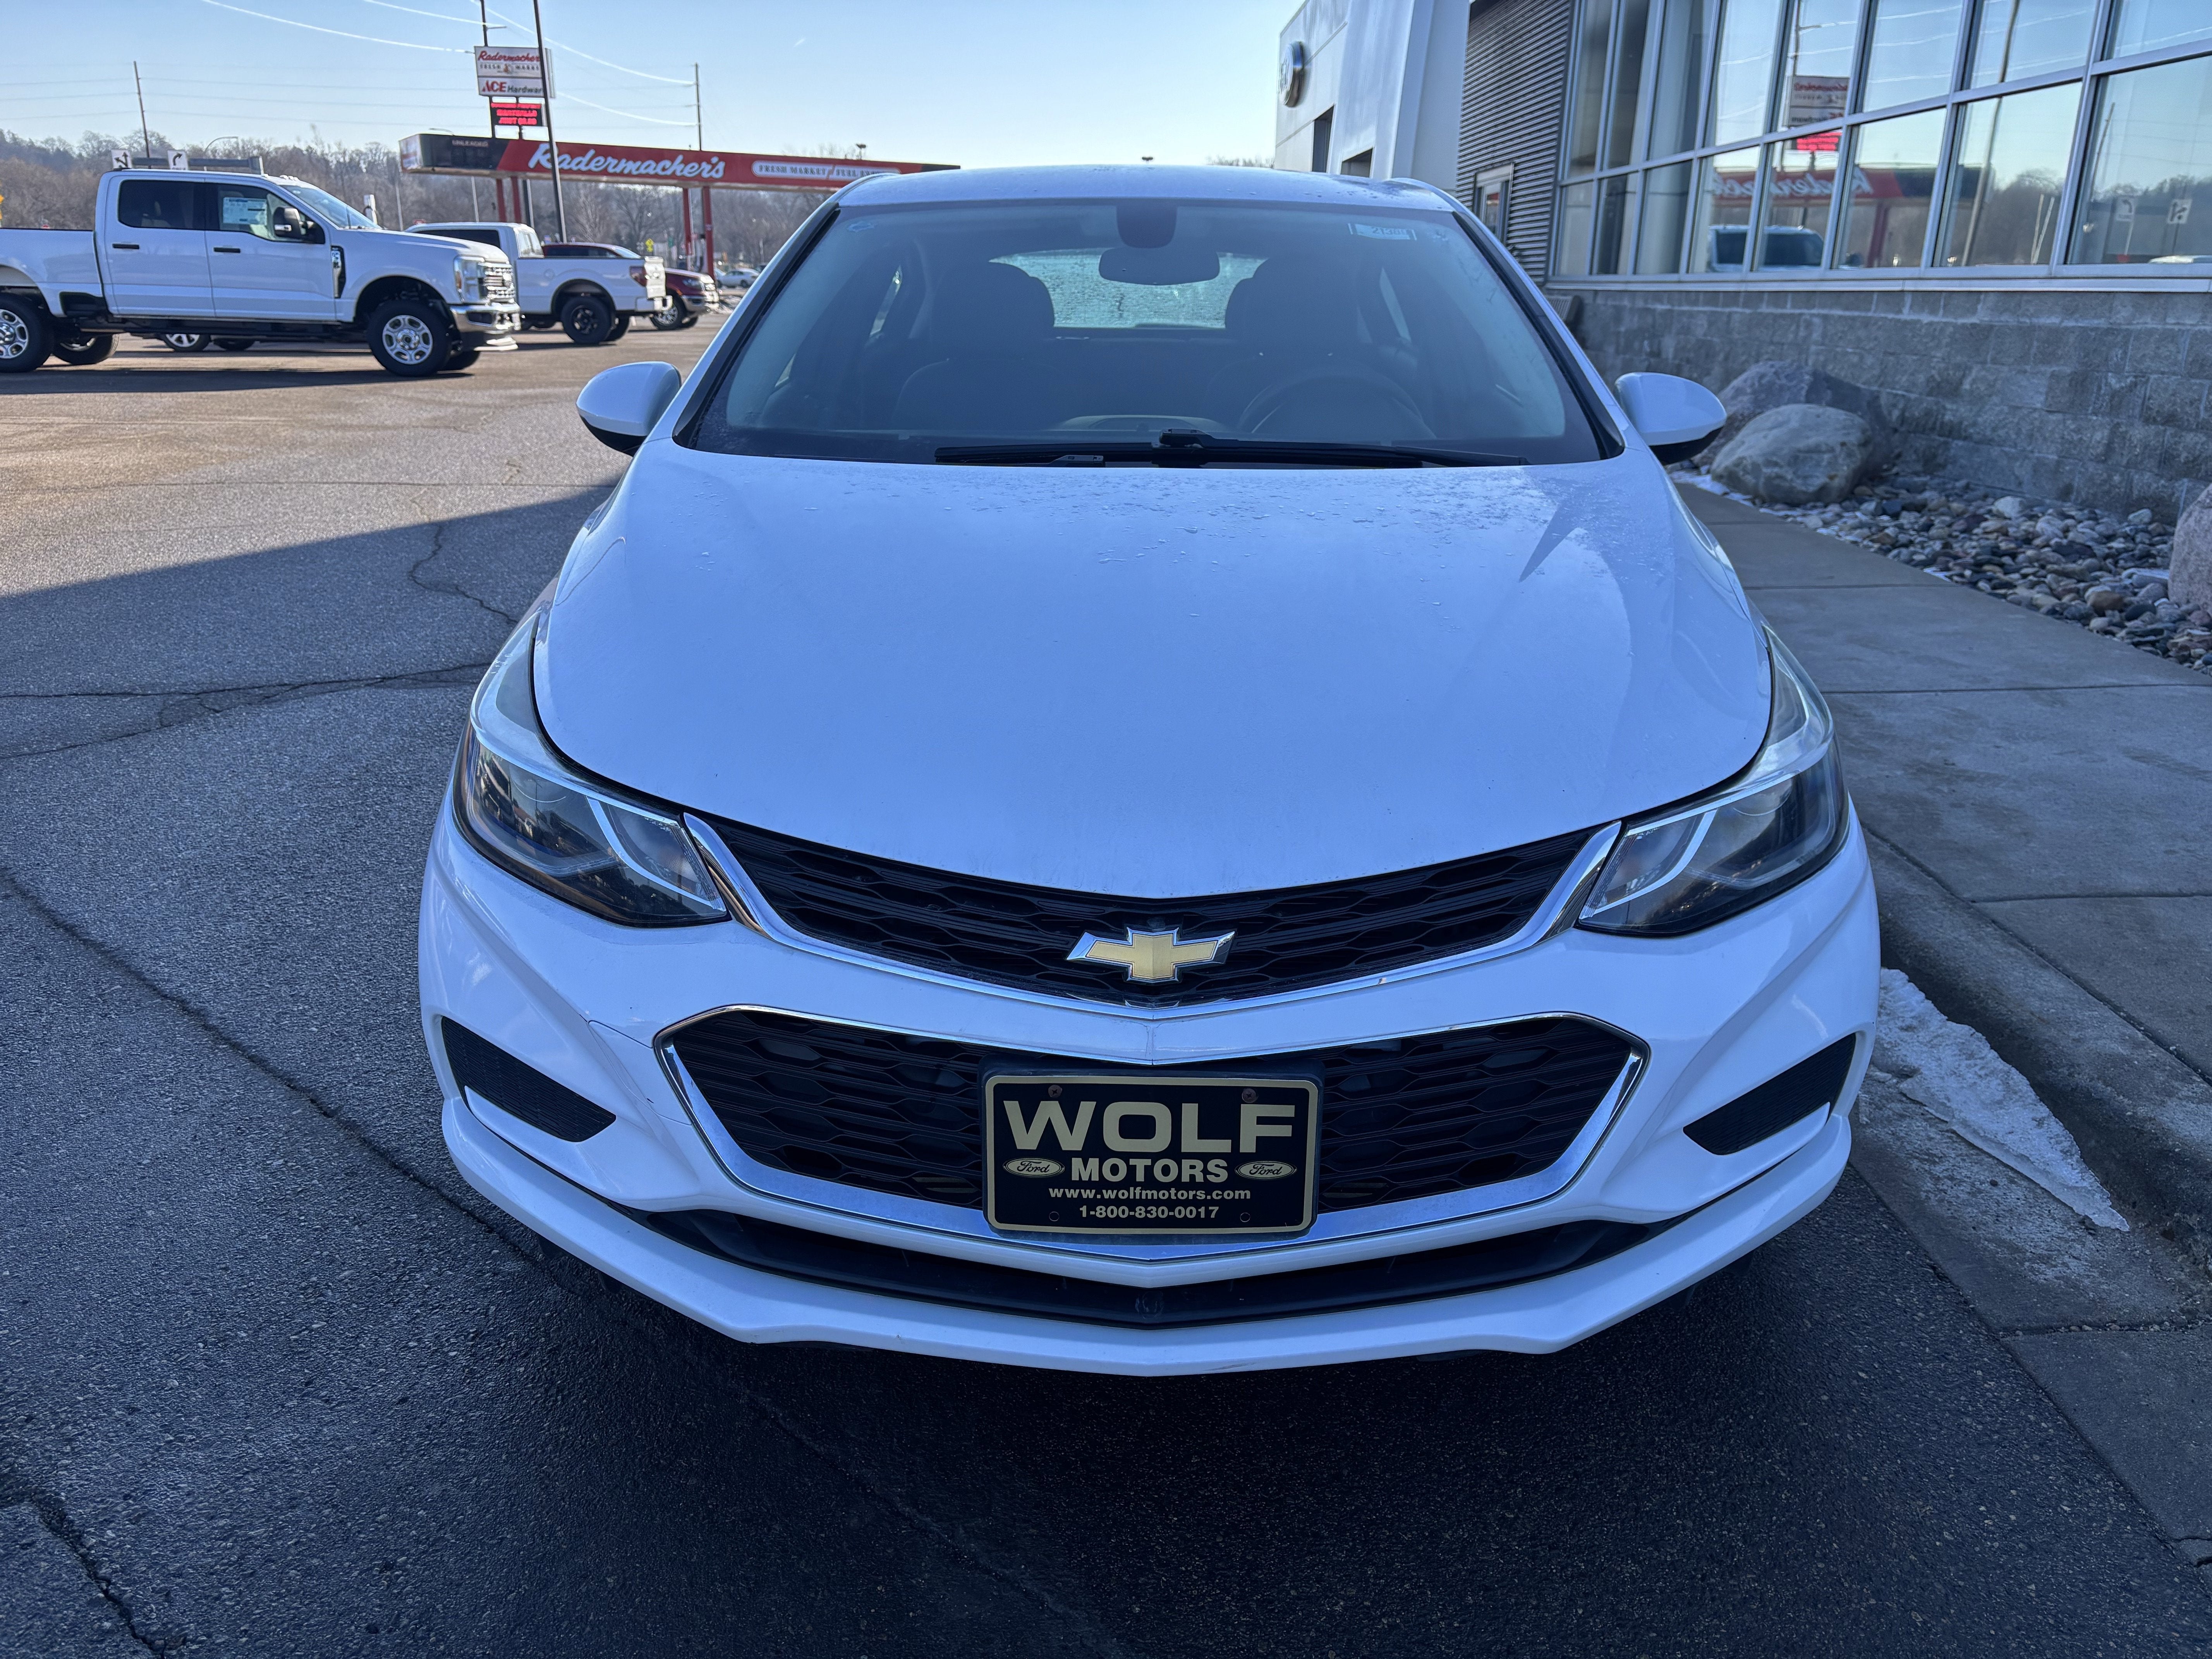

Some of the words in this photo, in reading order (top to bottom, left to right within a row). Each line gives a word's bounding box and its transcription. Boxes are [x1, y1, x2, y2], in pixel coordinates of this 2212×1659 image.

[477, 51, 540, 62] Radermacher
[483, 80, 507, 93] ACE
[507, 85, 542, 93] Hardwar
[528, 143, 725, 179] Radermacher's
[758, 165, 787, 173] FRESH
[790, 167, 826, 175] MARKET
[1003, 1100, 1295, 1153] WOLF
[1017, 1160, 1049, 1173] Ford
[1072, 1158, 1228, 1183] MOTORS
[1249, 1163, 1282, 1175] Ford
[1049, 1187, 1251, 1200] www.wolfmotors.com
[1080, 1205, 1219, 1219] 1-800-830-0017
